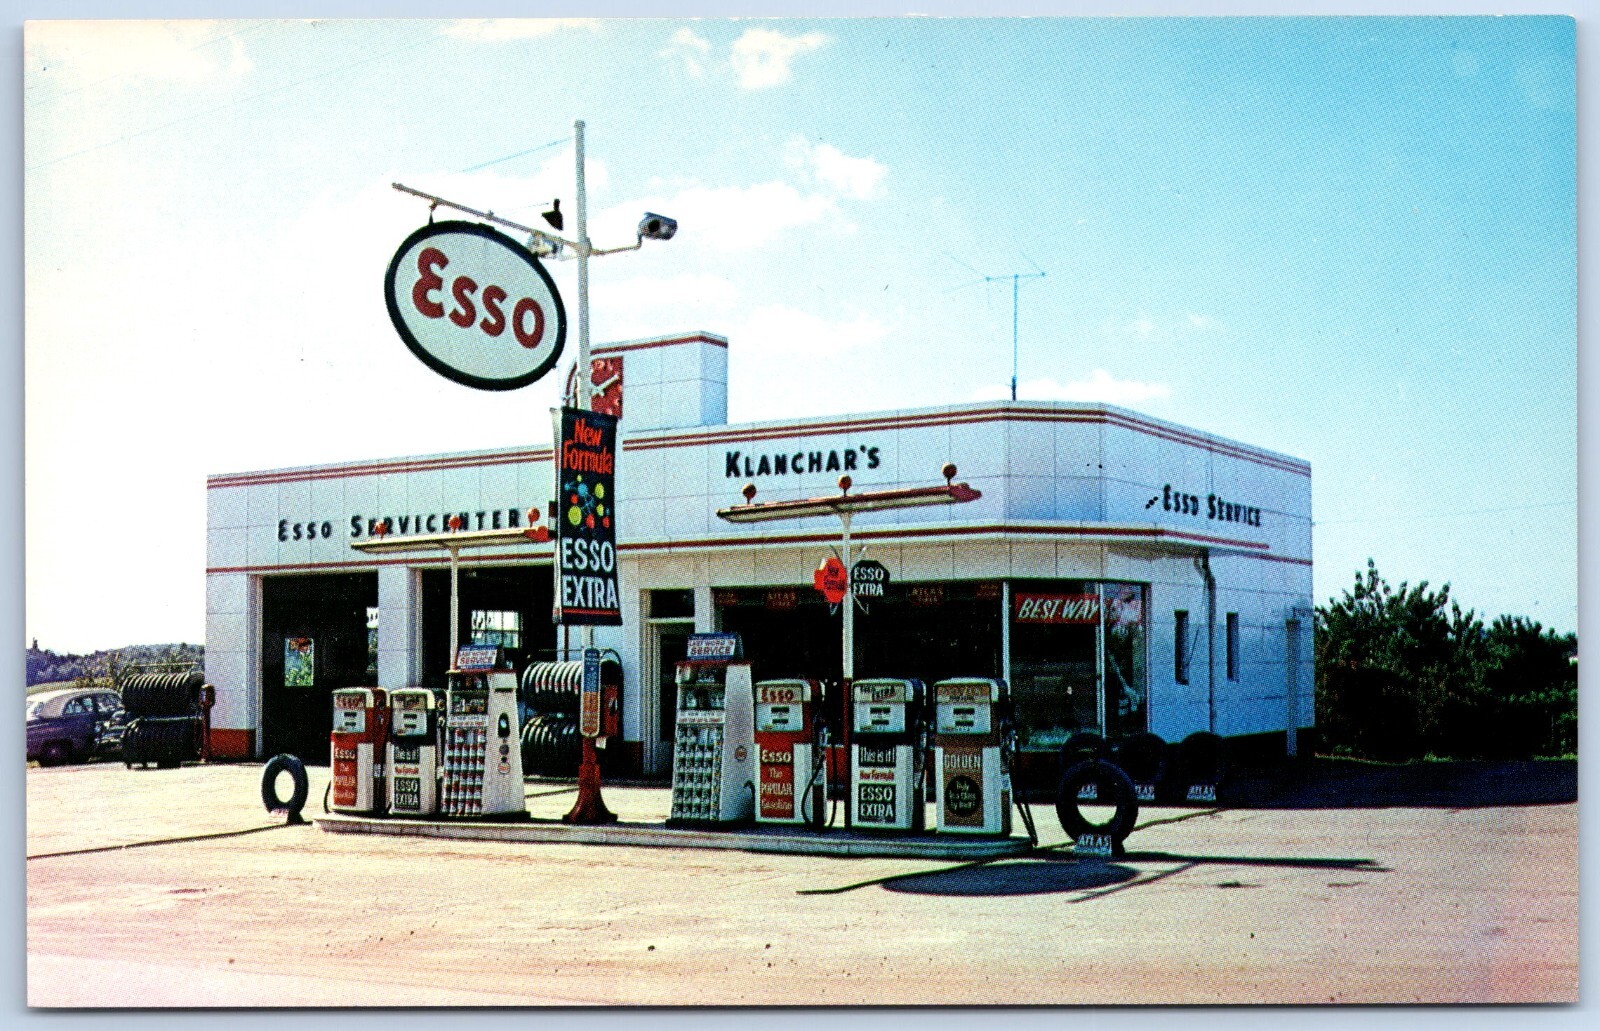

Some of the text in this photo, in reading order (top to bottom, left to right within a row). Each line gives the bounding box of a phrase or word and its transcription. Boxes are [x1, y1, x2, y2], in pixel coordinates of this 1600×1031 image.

[412, 246, 546, 350] ESSO
[574, 417, 603, 447] New
[562, 439, 613, 475] Formula
[725, 444, 880, 479] KLANCHAR'S
[1162, 483, 1200, 516] ESSO
[278, 519, 333, 542] ESSO
[561, 536, 615, 573] ESSO
[853, 566, 885, 580] ESSO
[561, 574, 619, 610] EXTRA
[853, 582, 884, 596] EXTRA
[761, 686, 795, 701] ESSO
[761, 749, 792, 763] ESSO
[944, 754, 981, 769] GOLDEN
[395, 779, 418, 793] ESSO
[760, 782, 793, 796] POPULAR
[860, 785, 893, 801] ESSO
[395, 793, 419, 806] EXTRA
[860, 803, 894, 818] EXTRA
[1079, 834, 1110, 846] ATLAS
